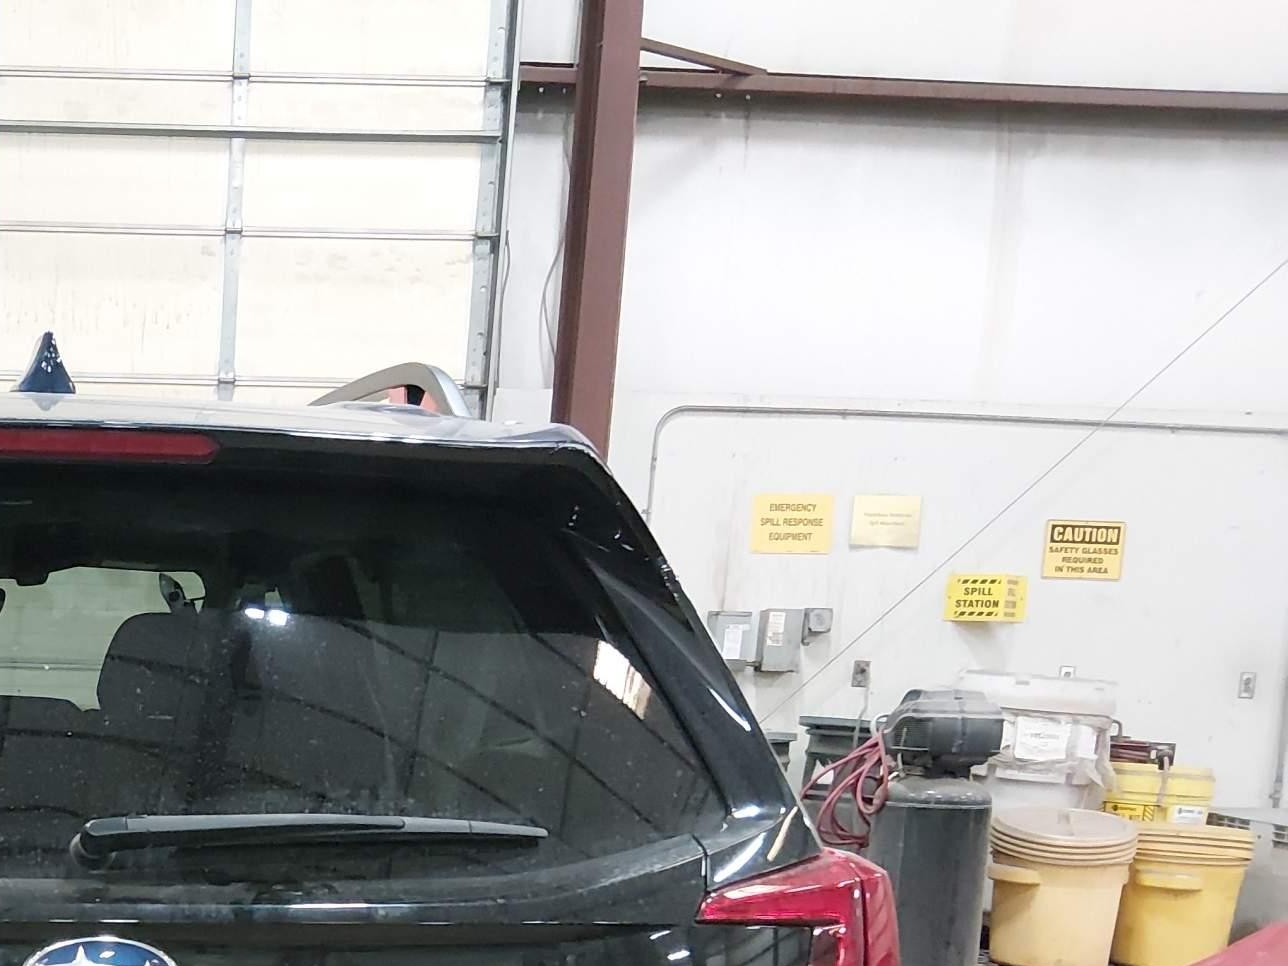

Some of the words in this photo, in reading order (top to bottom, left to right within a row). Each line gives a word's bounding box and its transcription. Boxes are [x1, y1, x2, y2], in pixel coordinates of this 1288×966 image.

[769, 503, 817, 513] EMERGENCY
[760, 517, 781, 527] SPILL
[782, 518, 824, 527] RESPONSE
[768, 532, 813, 541] EQUIPMENT
[1053, 526, 1119, 543] CAUTION
[1049, 546, 1079, 555] SAFETY
[1082, 547, 1119, 555] GLASSES
[1087, 567, 1109, 575] AREA
[963, 587, 993, 596] SPILL
[955, 599, 1000, 609] STATION
